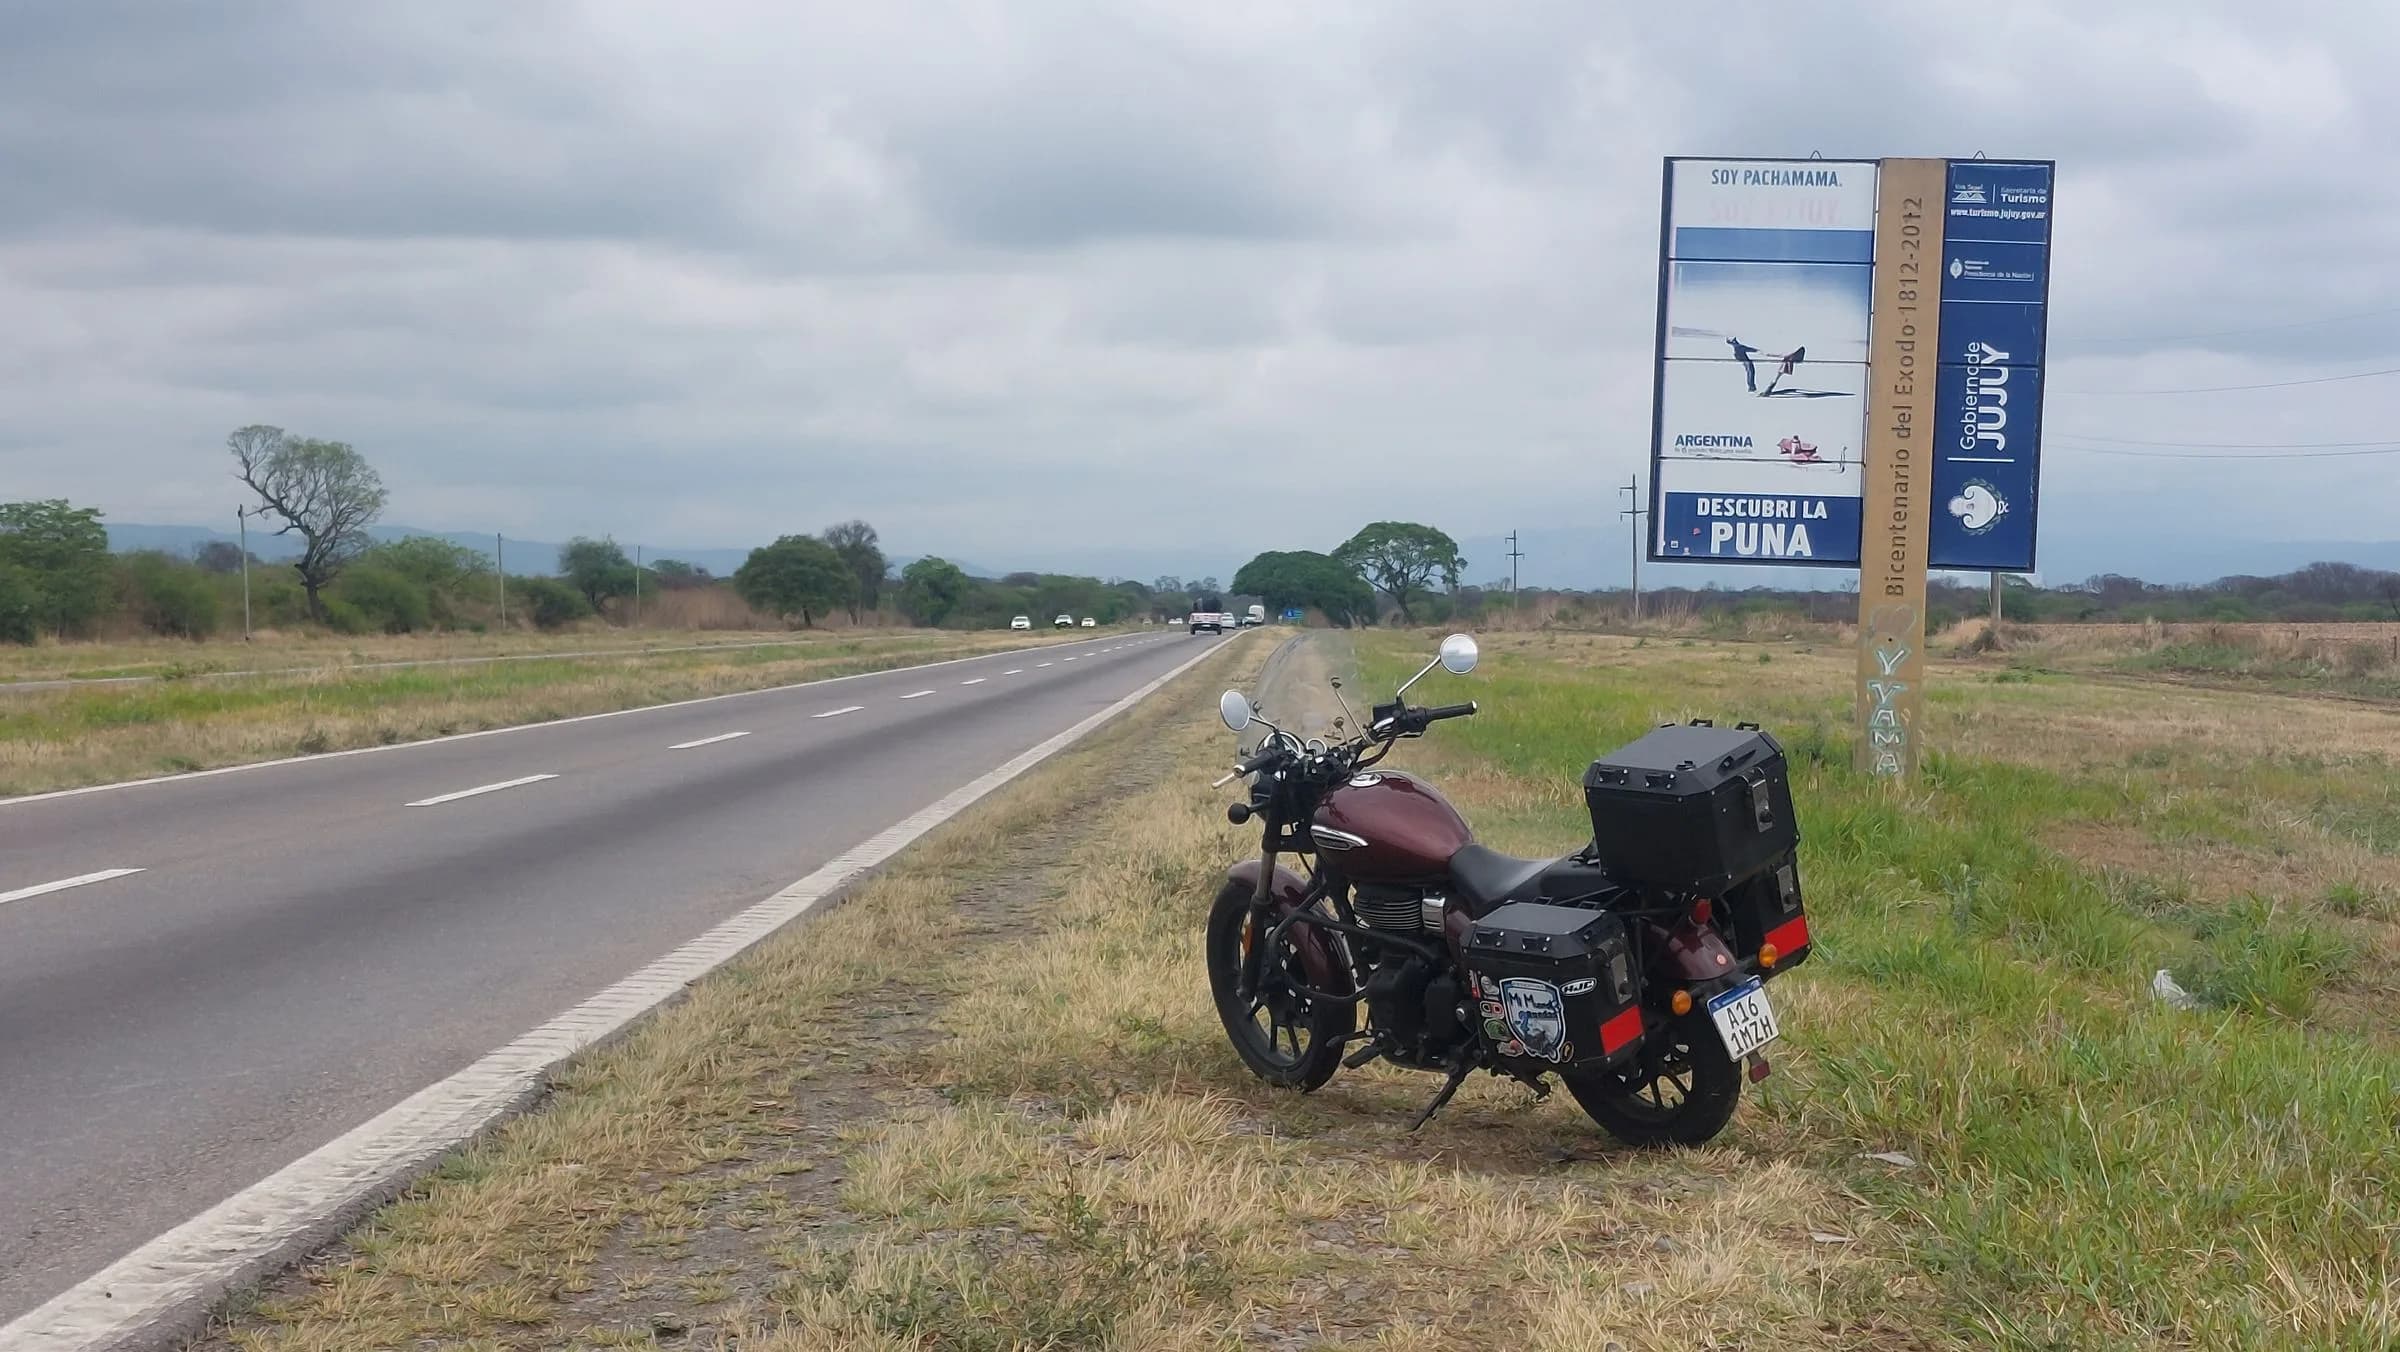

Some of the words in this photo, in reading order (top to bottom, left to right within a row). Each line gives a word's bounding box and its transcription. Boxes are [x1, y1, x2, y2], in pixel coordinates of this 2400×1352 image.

[1711, 168, 1738, 185] SOY
[1743, 169, 1843, 188] PACHAMAMA.
[2000, 193, 2047, 204] Turismo
[1976, 341, 2010, 451] JUJUY
[1891, 401, 1913, 439] del
[1674, 434, 1753, 448] ARGENTINA
[1696, 497, 1796, 519] DESCUBRI
[1802, 501, 1828, 520] LA
[1885, 448, 1911, 597] Bicentenario
[1709, 521, 1813, 557] PUNA
[1562, 980, 1595, 994] HJC
[1726, 995, 1759, 1030] A16
[1731, 1015, 1773, 1055] 1MZH
